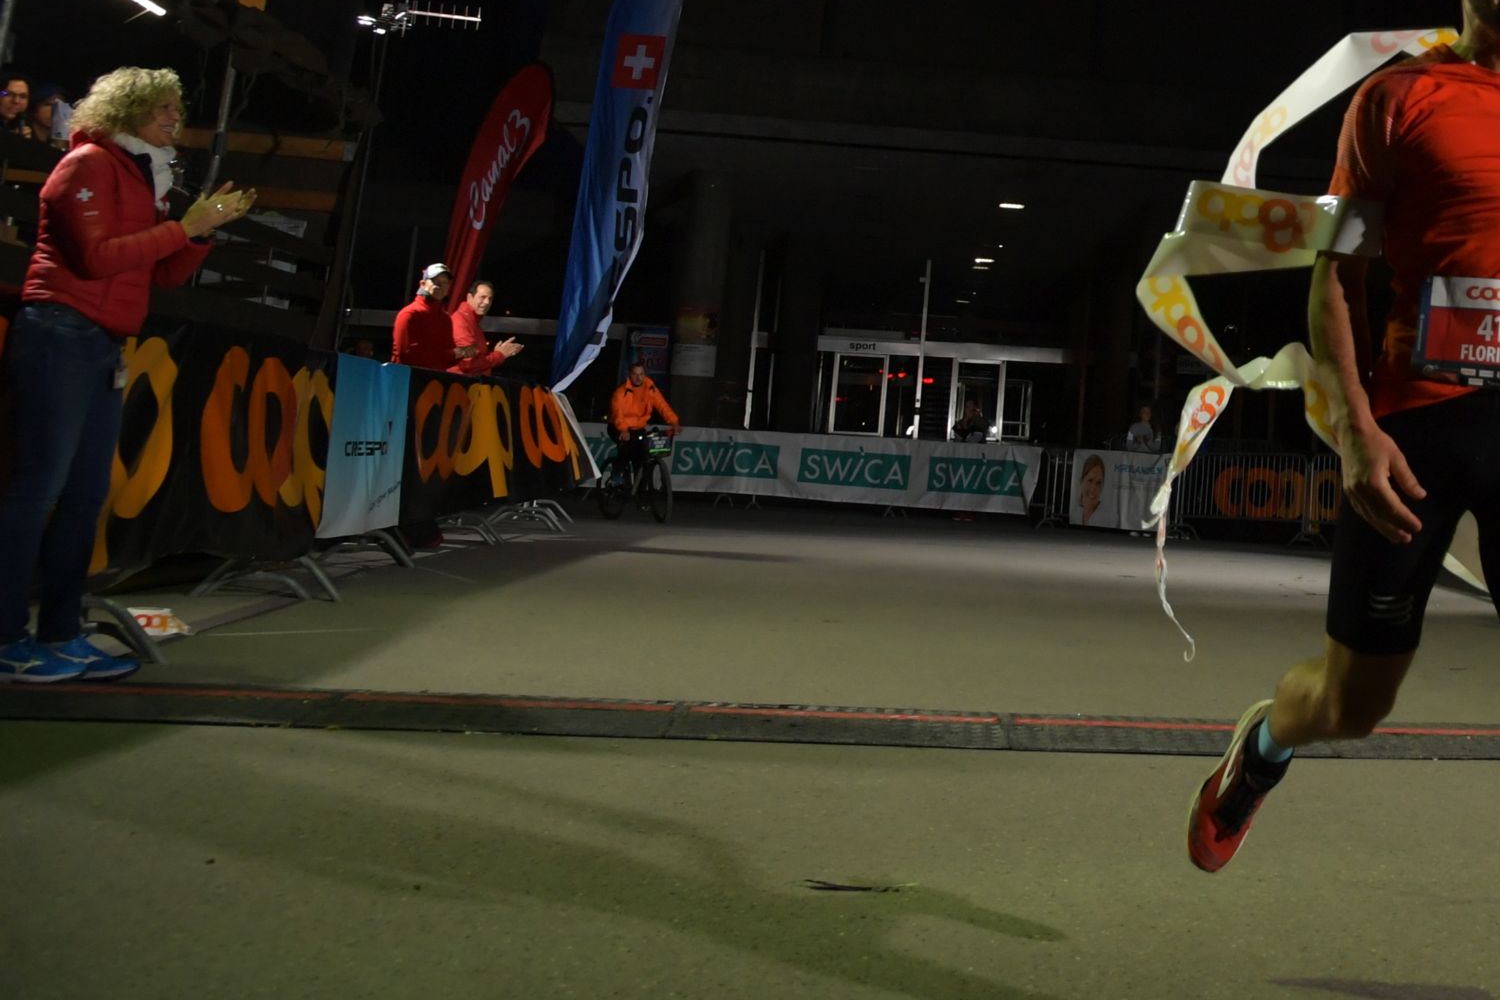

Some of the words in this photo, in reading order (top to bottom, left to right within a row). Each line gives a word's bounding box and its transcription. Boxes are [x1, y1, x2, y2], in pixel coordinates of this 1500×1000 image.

[470, 109, 530, 231] Canal3
[850, 342, 876, 351] sport
[416, 380, 513, 498] coop
[677, 438, 775, 475] SWICA
[805, 448, 904, 486] SWICA
[933, 455, 1024, 493] SWICA
